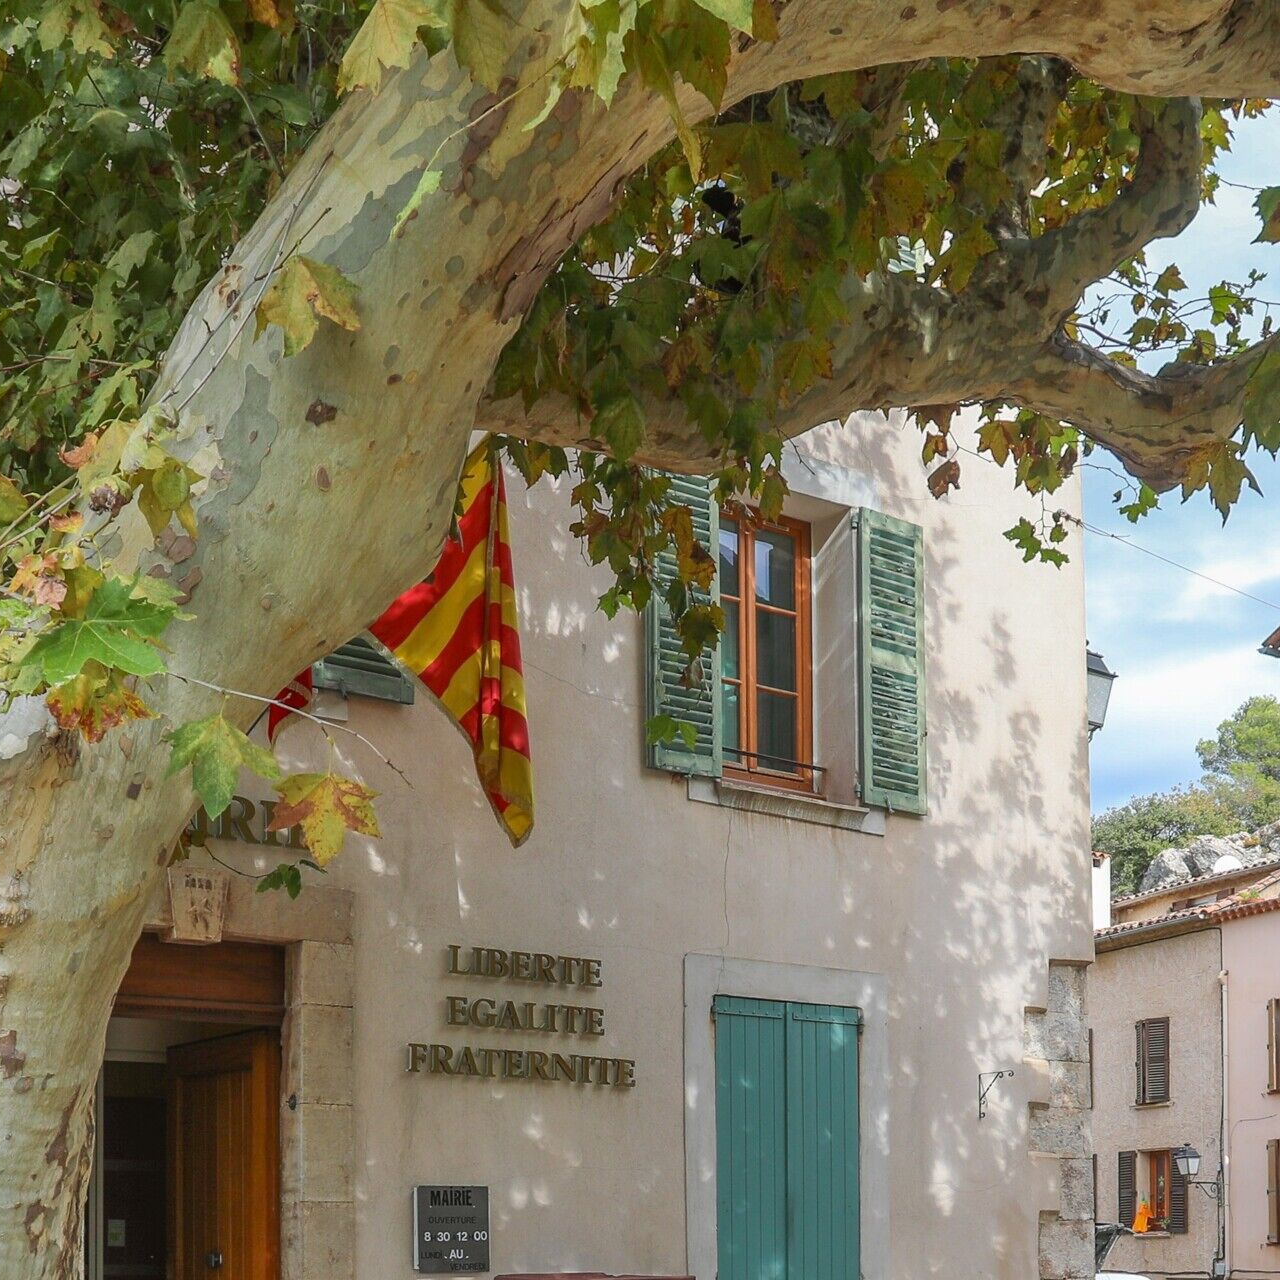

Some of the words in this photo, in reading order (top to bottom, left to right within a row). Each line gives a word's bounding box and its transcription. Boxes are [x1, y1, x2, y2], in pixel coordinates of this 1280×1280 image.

[447, 944, 603, 987] LIBERTE
[446, 996, 605, 1036] EGALITE
[406, 1043, 636, 1087] FRATERNITE
[428, 1216, 477, 1224] OUVERTURE
[449, 1249, 464, 1259] AU
